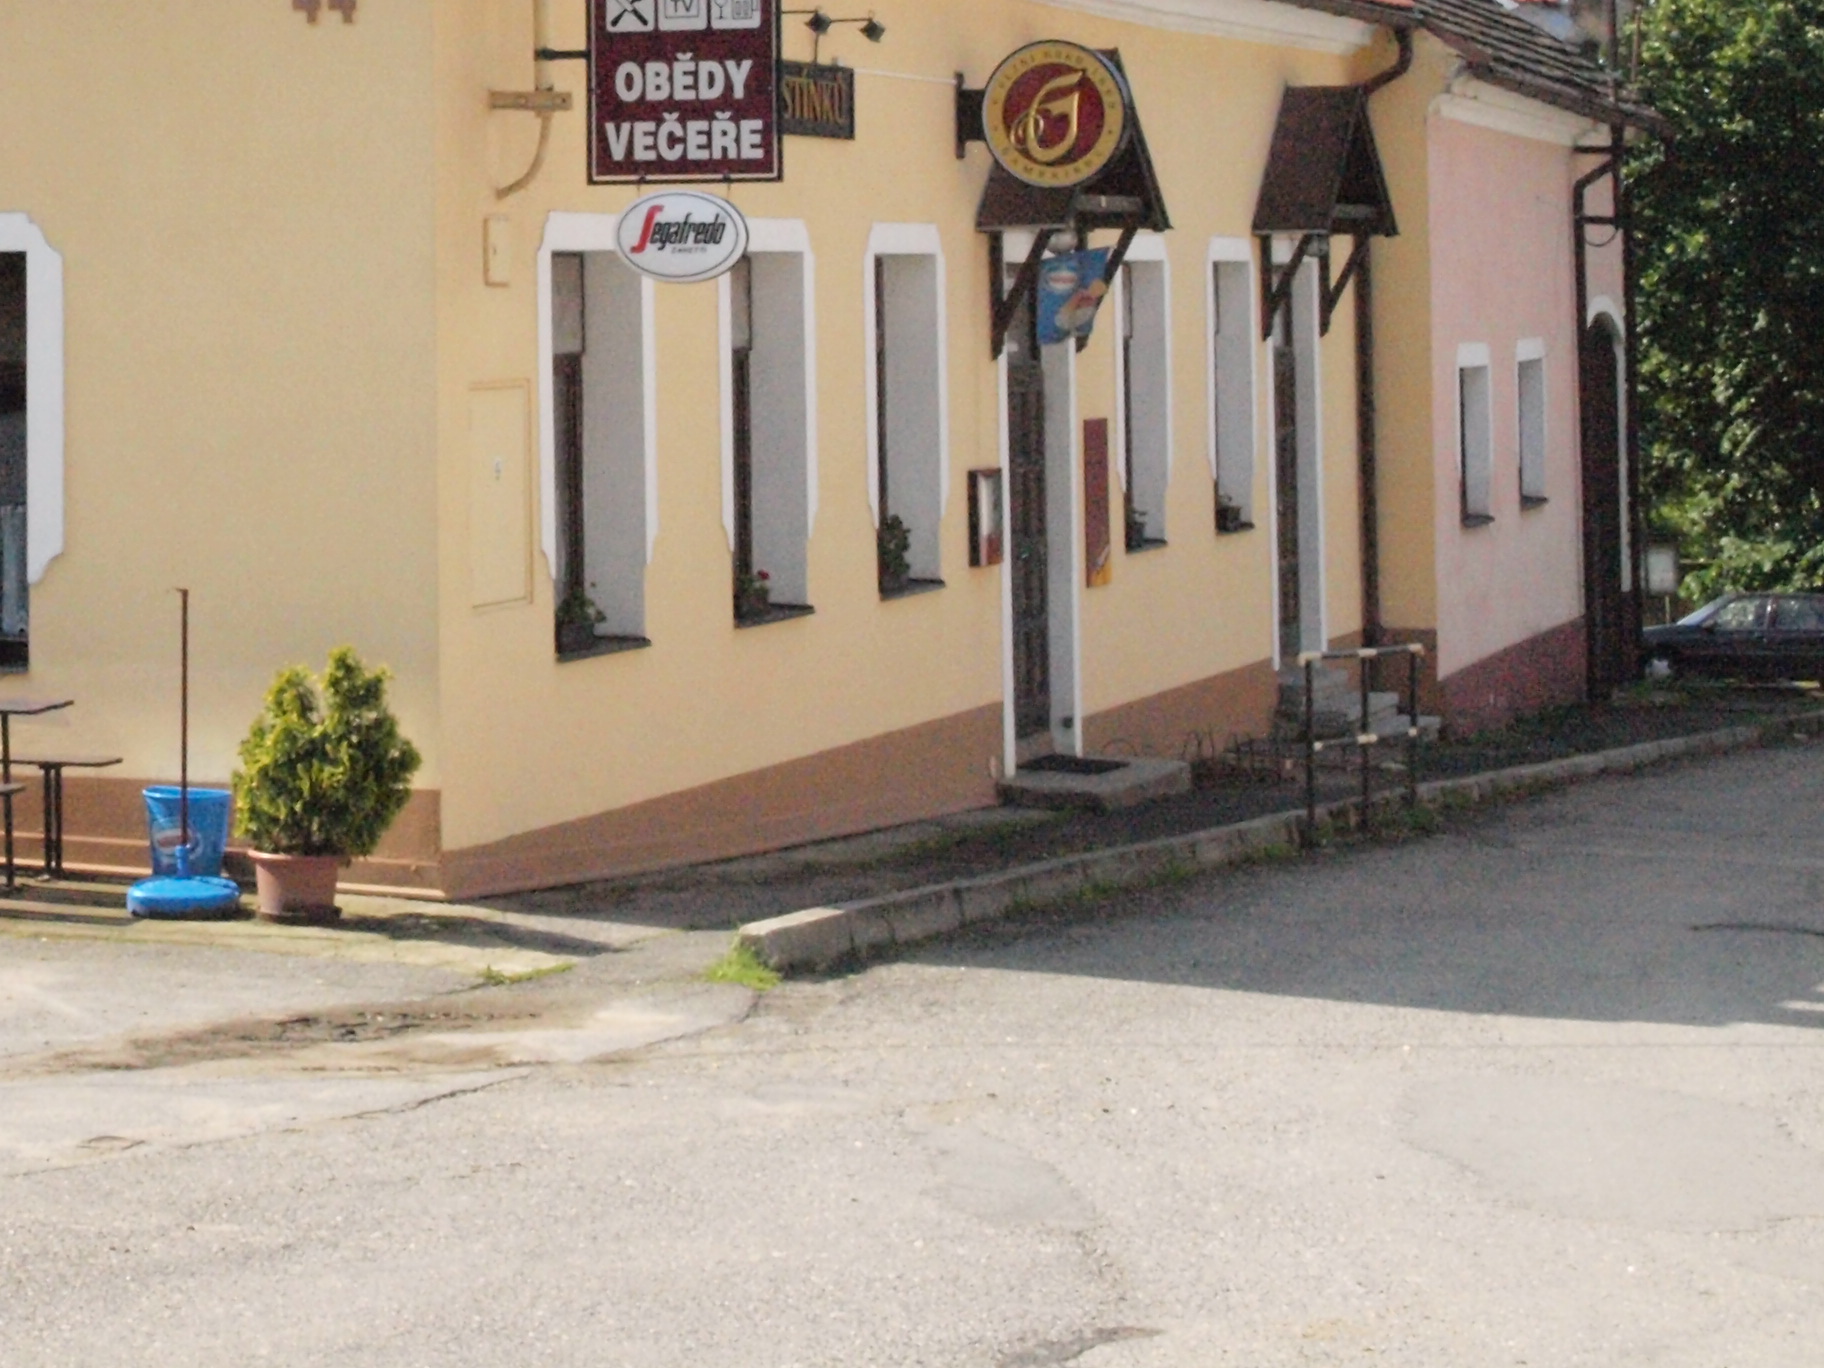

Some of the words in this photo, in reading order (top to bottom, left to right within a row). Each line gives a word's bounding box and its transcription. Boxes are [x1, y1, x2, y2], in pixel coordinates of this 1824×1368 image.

[615, 52, 753, 102] OBĚDY
[781, 68, 849, 127] STÍNKŮ
[604, 111, 765, 161] VEČEŘE
[629, 204, 726, 253] Segafredo
